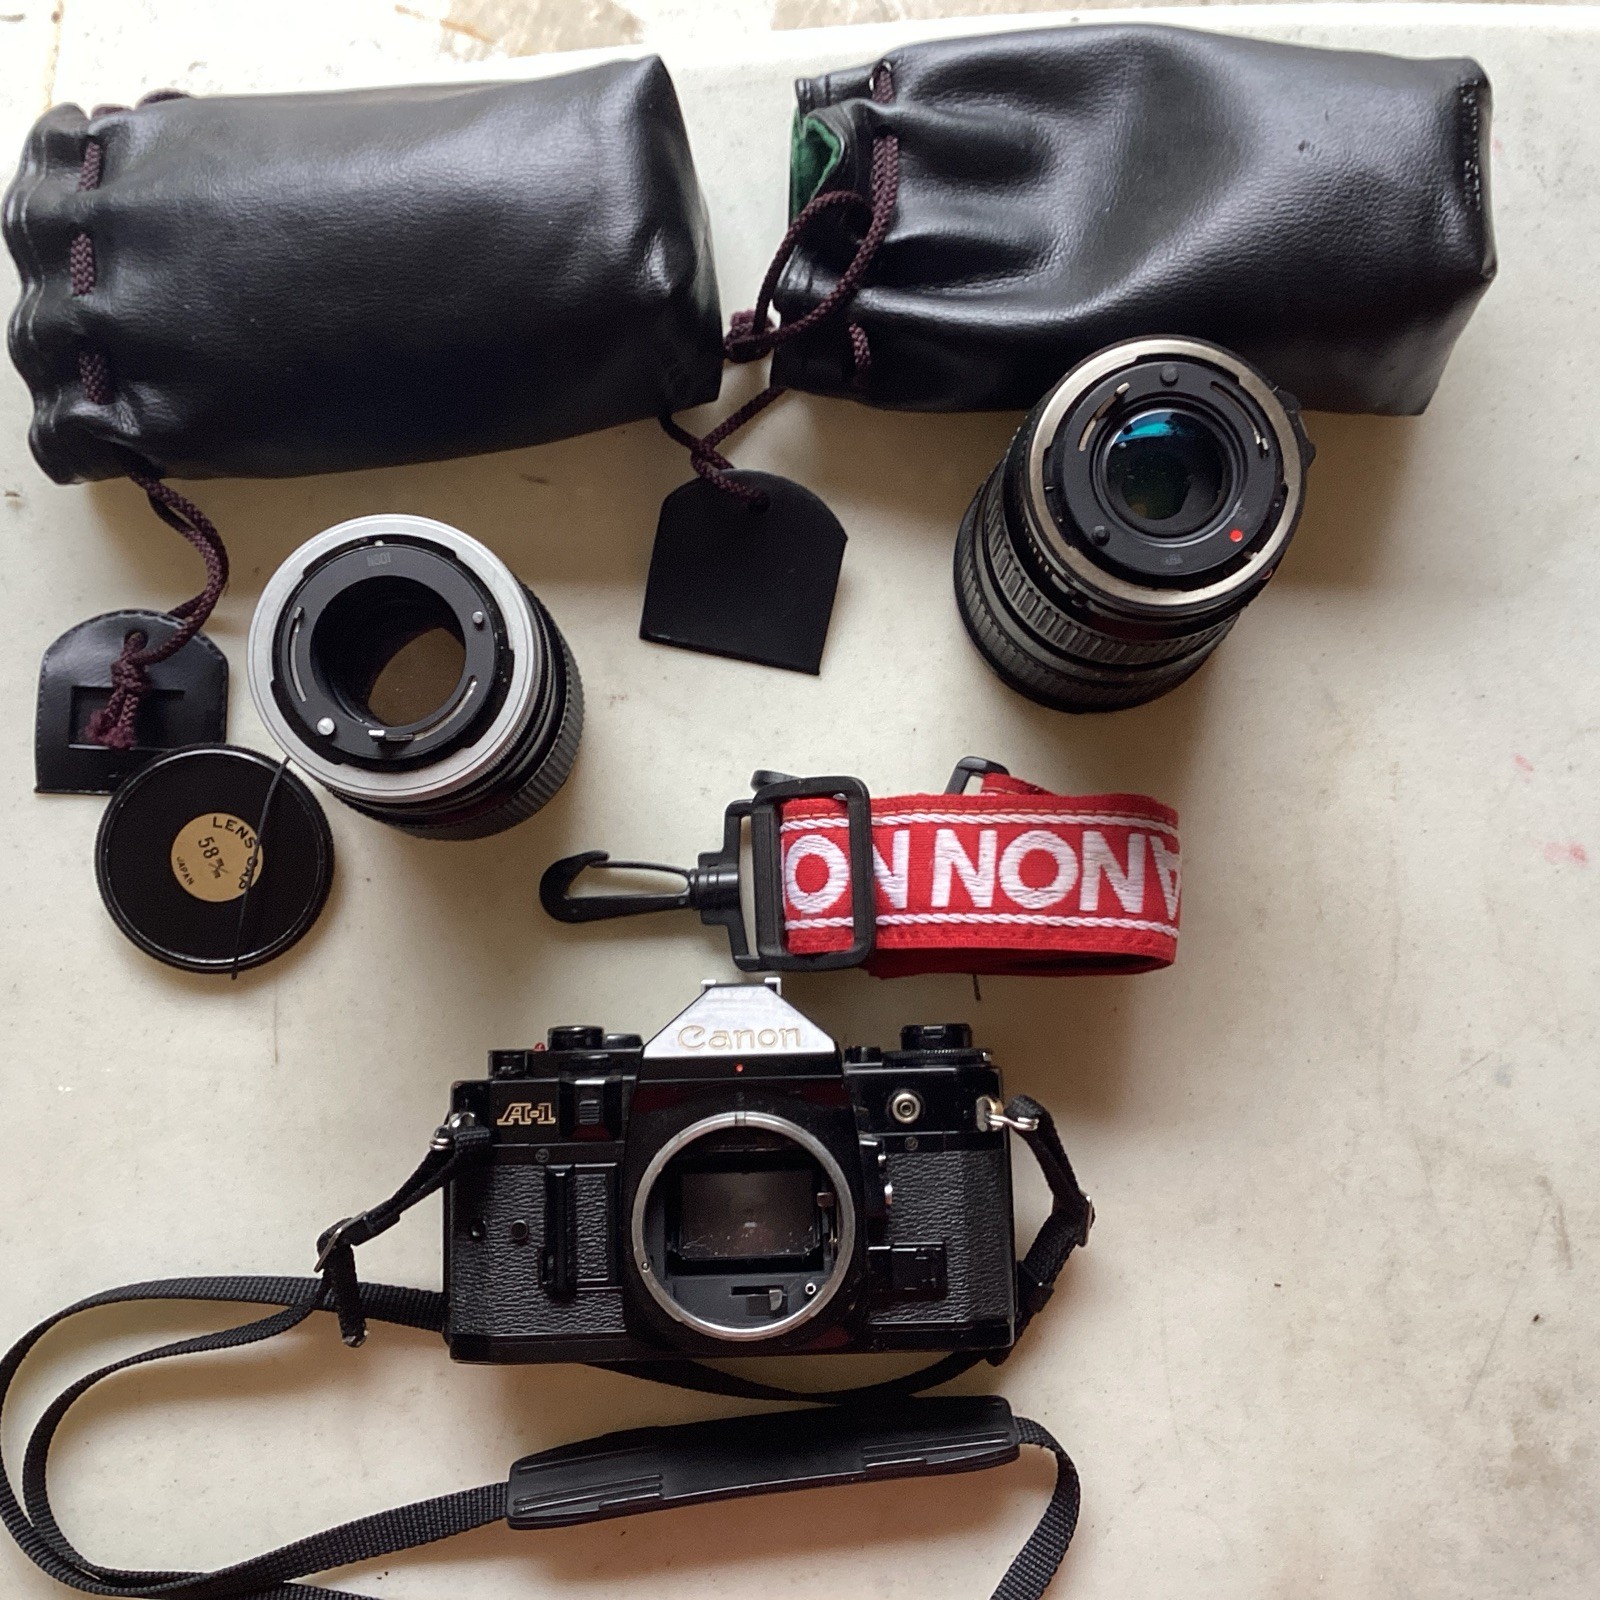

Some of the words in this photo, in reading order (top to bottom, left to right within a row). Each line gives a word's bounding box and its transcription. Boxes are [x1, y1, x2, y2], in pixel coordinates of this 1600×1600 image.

[212, 816, 256, 849] LENS
[176, 856, 195, 886] JAPAN
[677, 1024, 802, 1051] Canon
[496, 1102, 556, 1126] A-1
